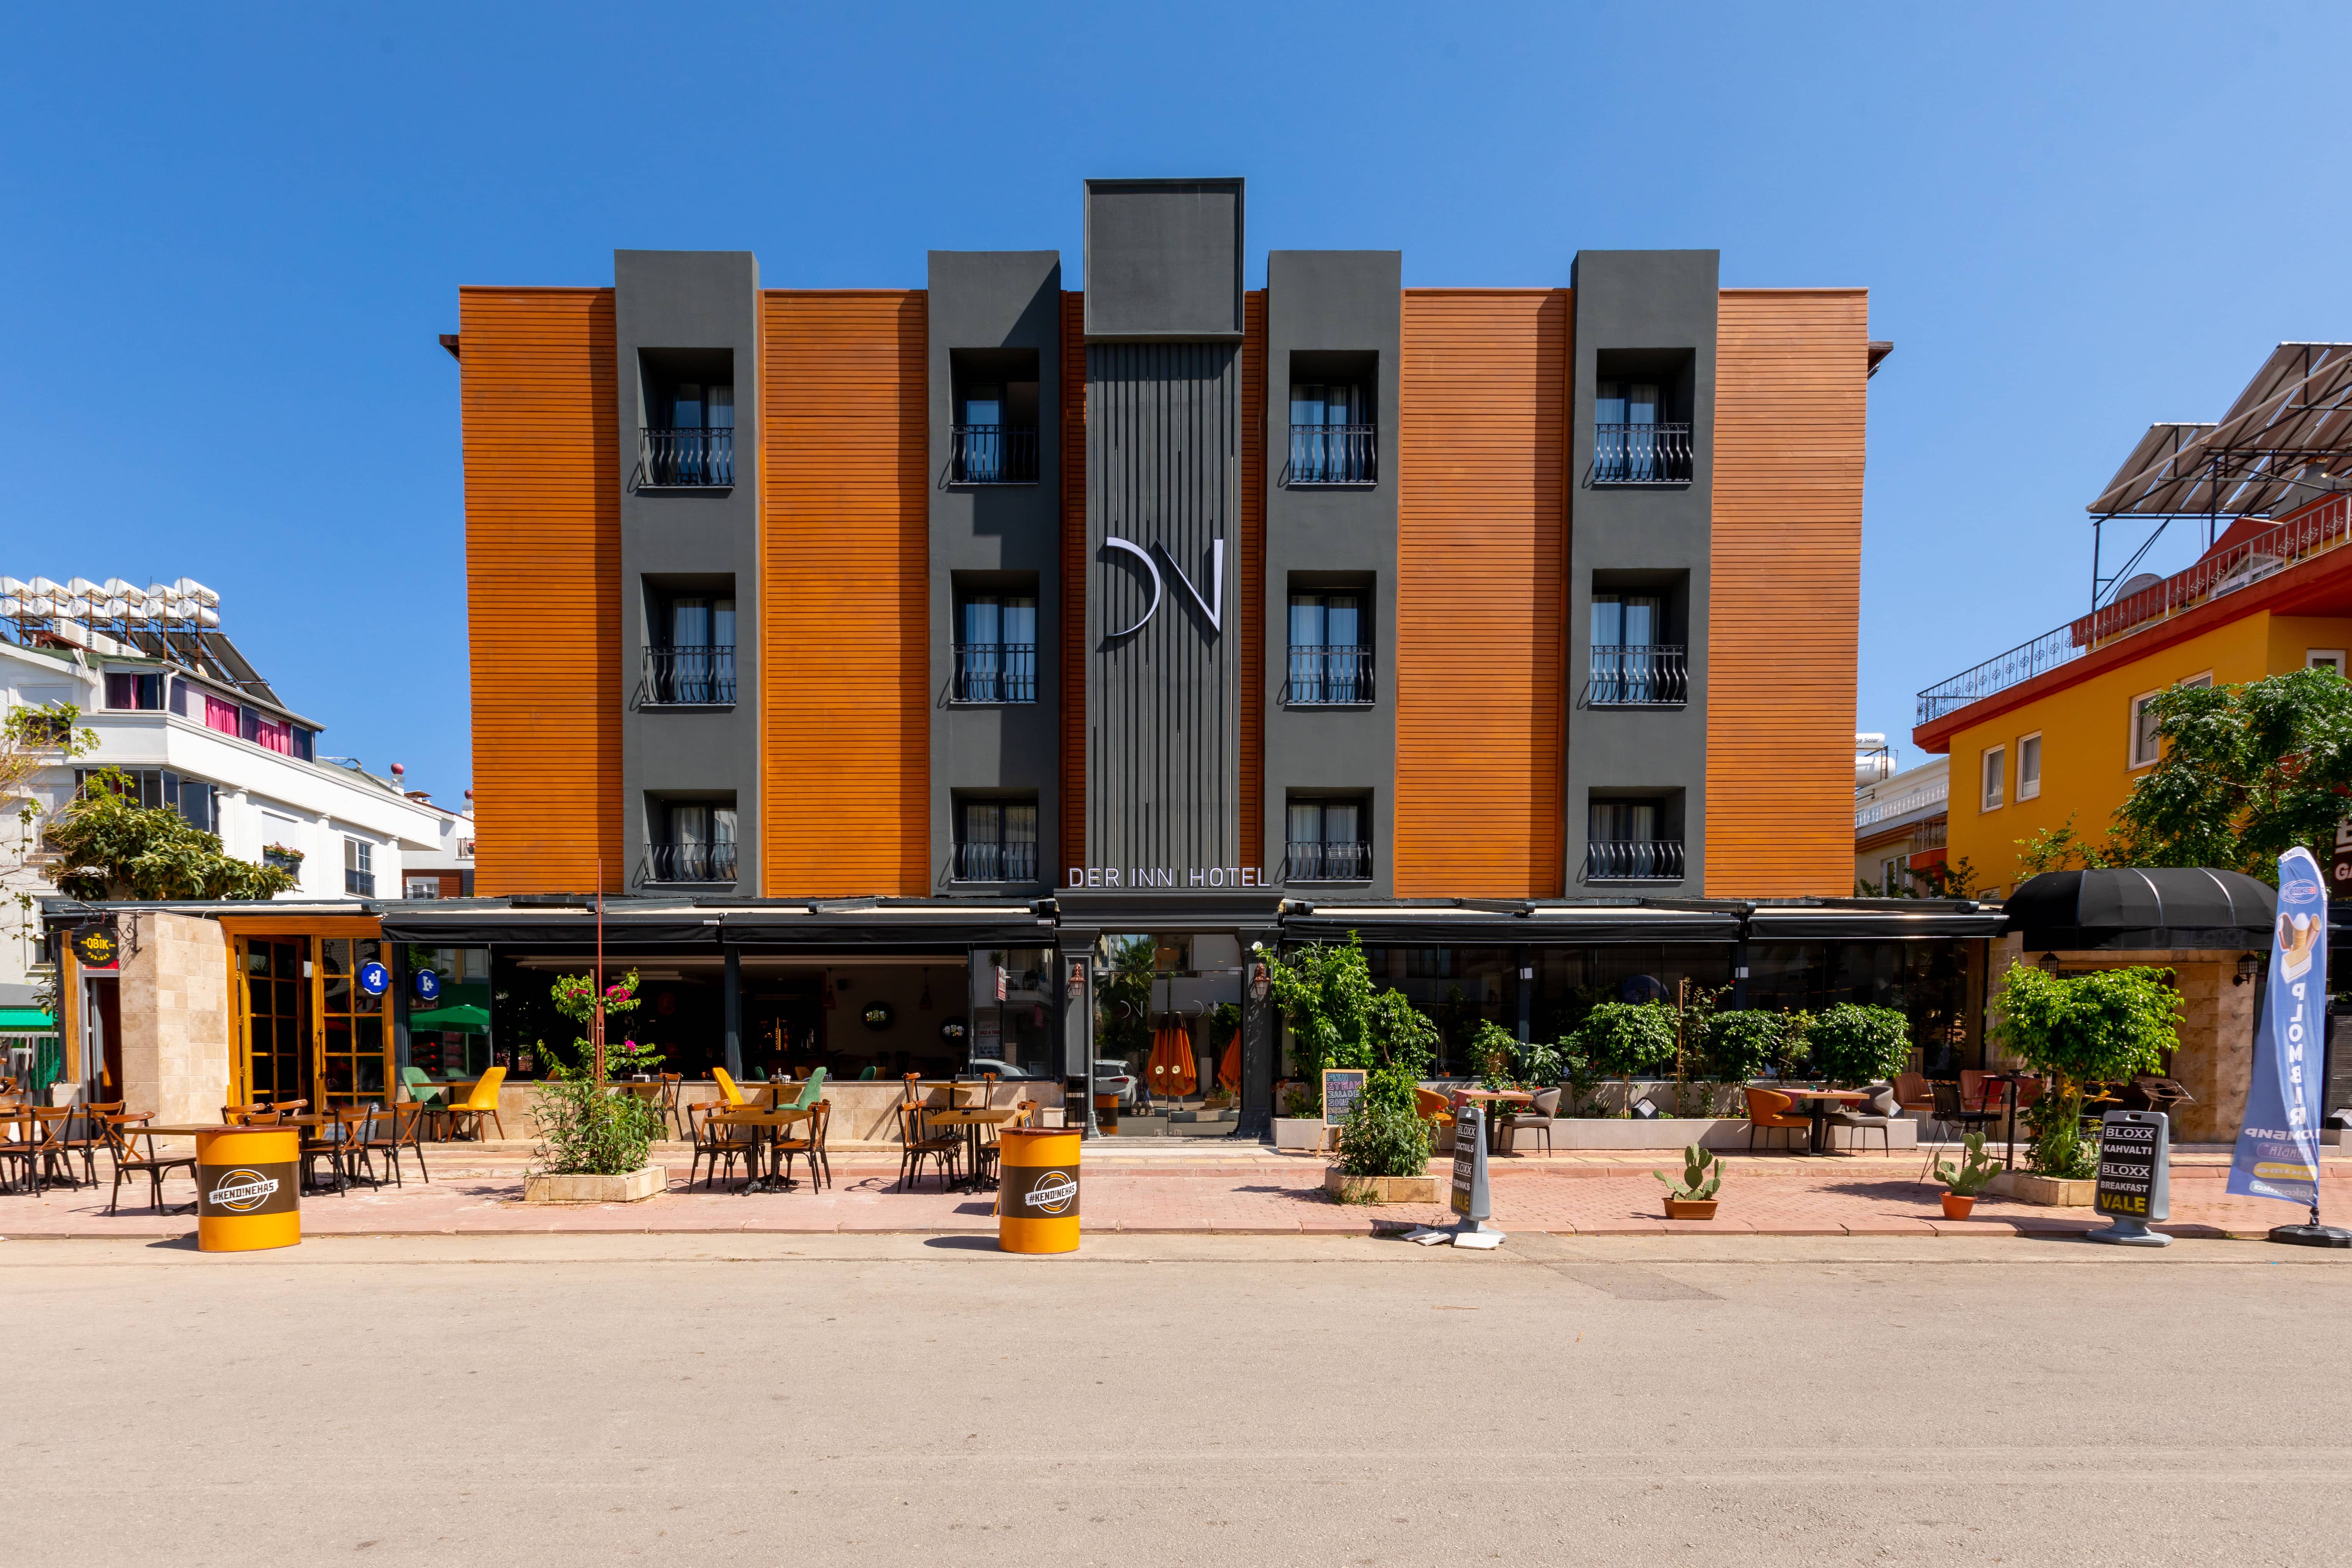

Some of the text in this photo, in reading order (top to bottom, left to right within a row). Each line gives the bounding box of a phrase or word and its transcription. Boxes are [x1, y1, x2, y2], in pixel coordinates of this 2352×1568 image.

[1069, 867, 1270, 887] DER INN HOTEL
[87, 938, 109, 950] QBIK
[1327, 1081, 1361, 1090] STEAK
[1458, 1125, 1476, 1136] BLOXX
[2106, 1128, 2154, 1139] BLOXX
[1456, 1142, 1474, 1153] COCTAILS
[2104, 1144, 2152, 1154] KAHVALTI
[1454, 1162, 1472, 1175] BLOXX
[2102, 1164, 2150, 1177] BLOXX
[1453, 1179, 1470, 1191] DRINKS
[2101, 1181, 2148, 1193] BREAKFAST
[1453, 1191, 1469, 1211] VALE
[2101, 1193, 2146, 1212] VALE
